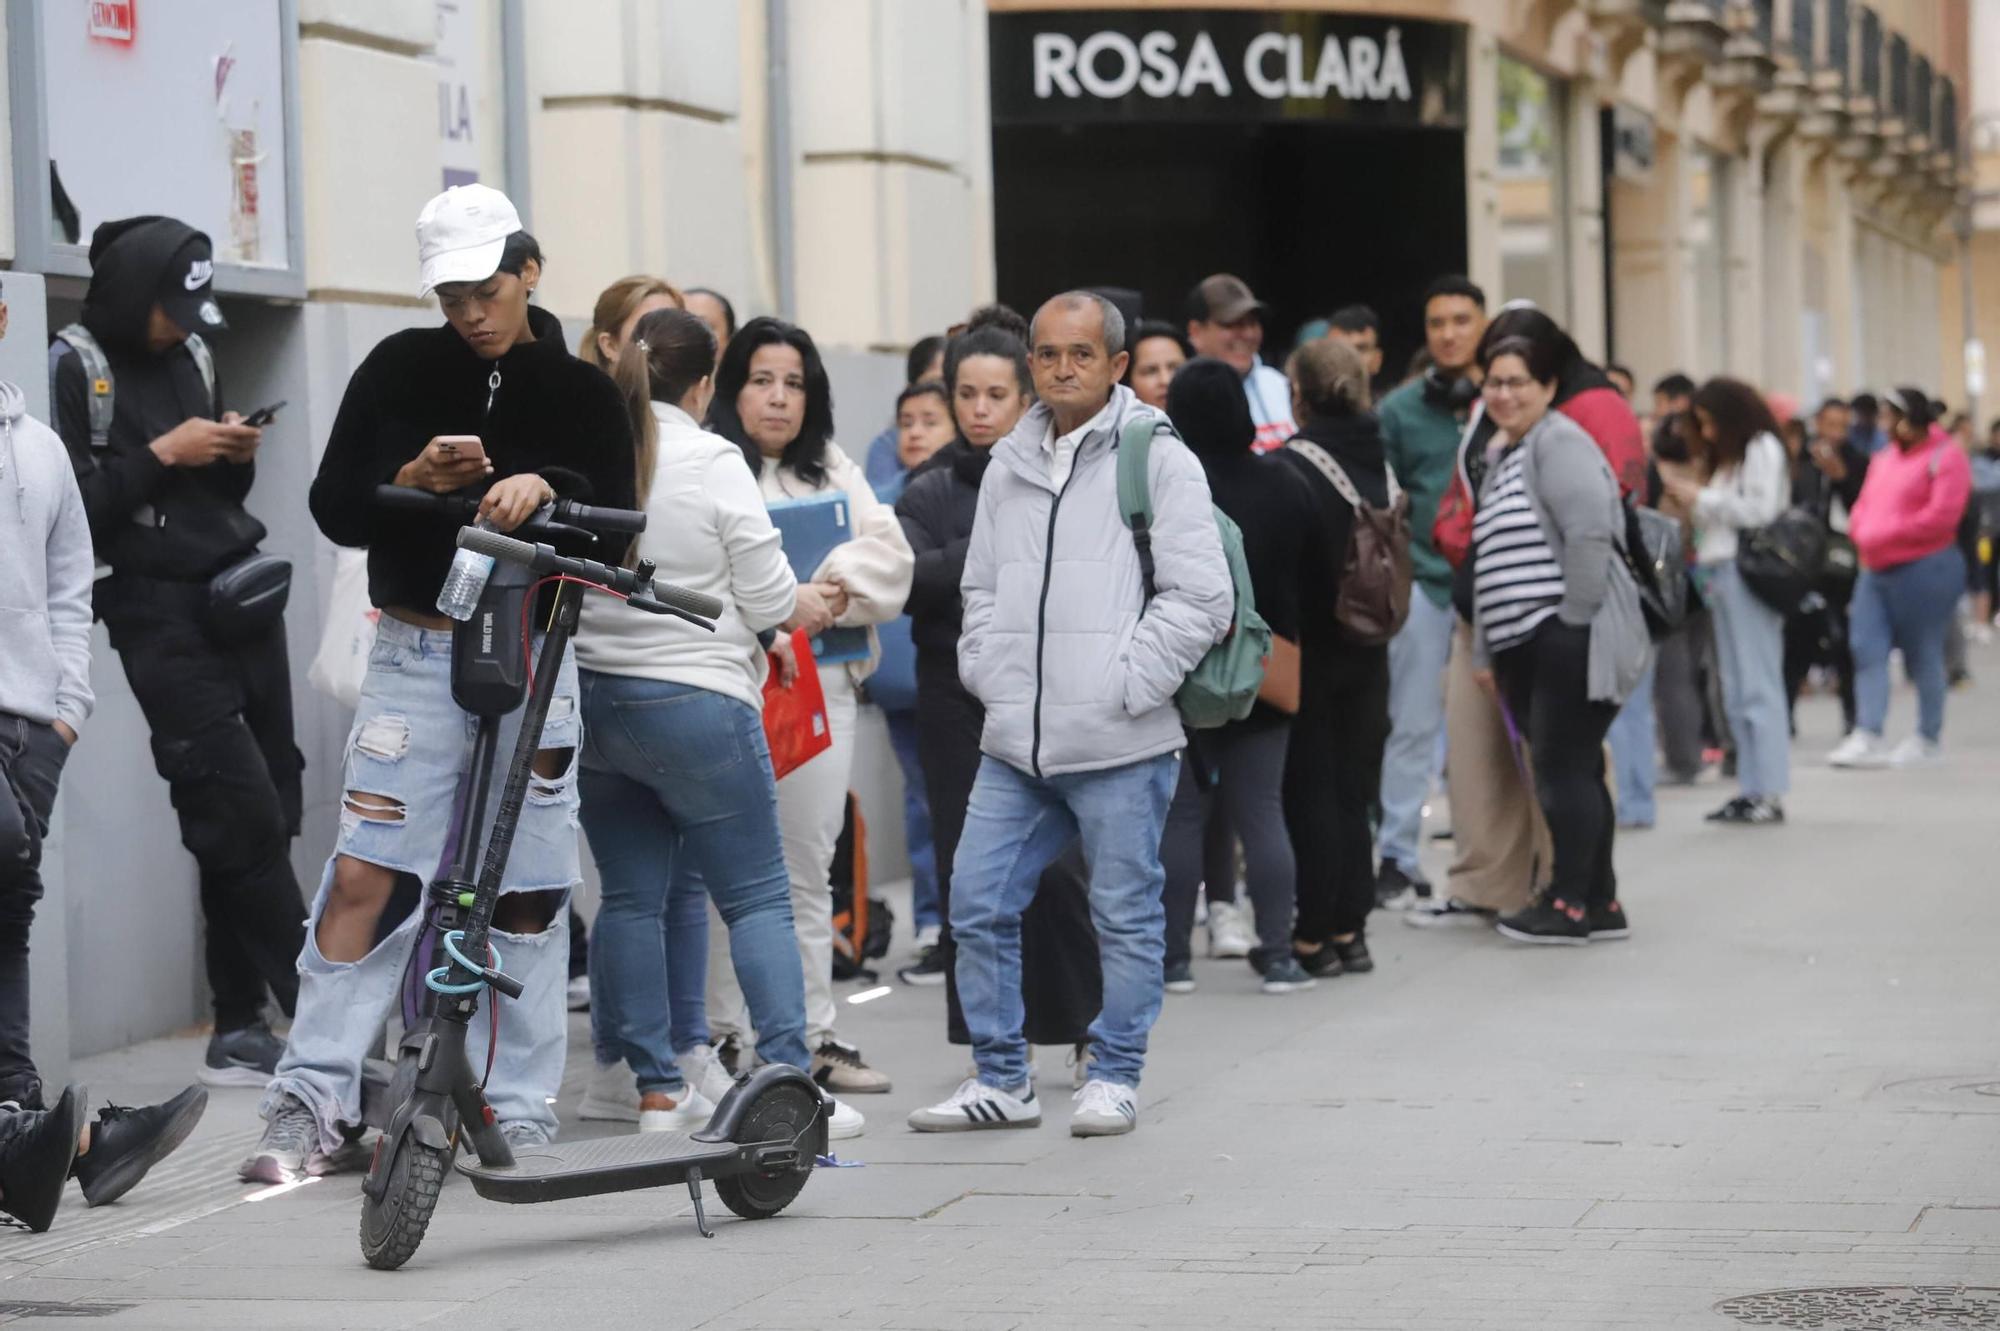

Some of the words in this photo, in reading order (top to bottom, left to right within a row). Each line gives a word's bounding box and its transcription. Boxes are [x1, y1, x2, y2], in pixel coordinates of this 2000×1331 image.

[1033, 31, 1232, 98] ROSA
[1244, 26, 1411, 100] CLARÁ
[482, 612, 493, 634] WILD
